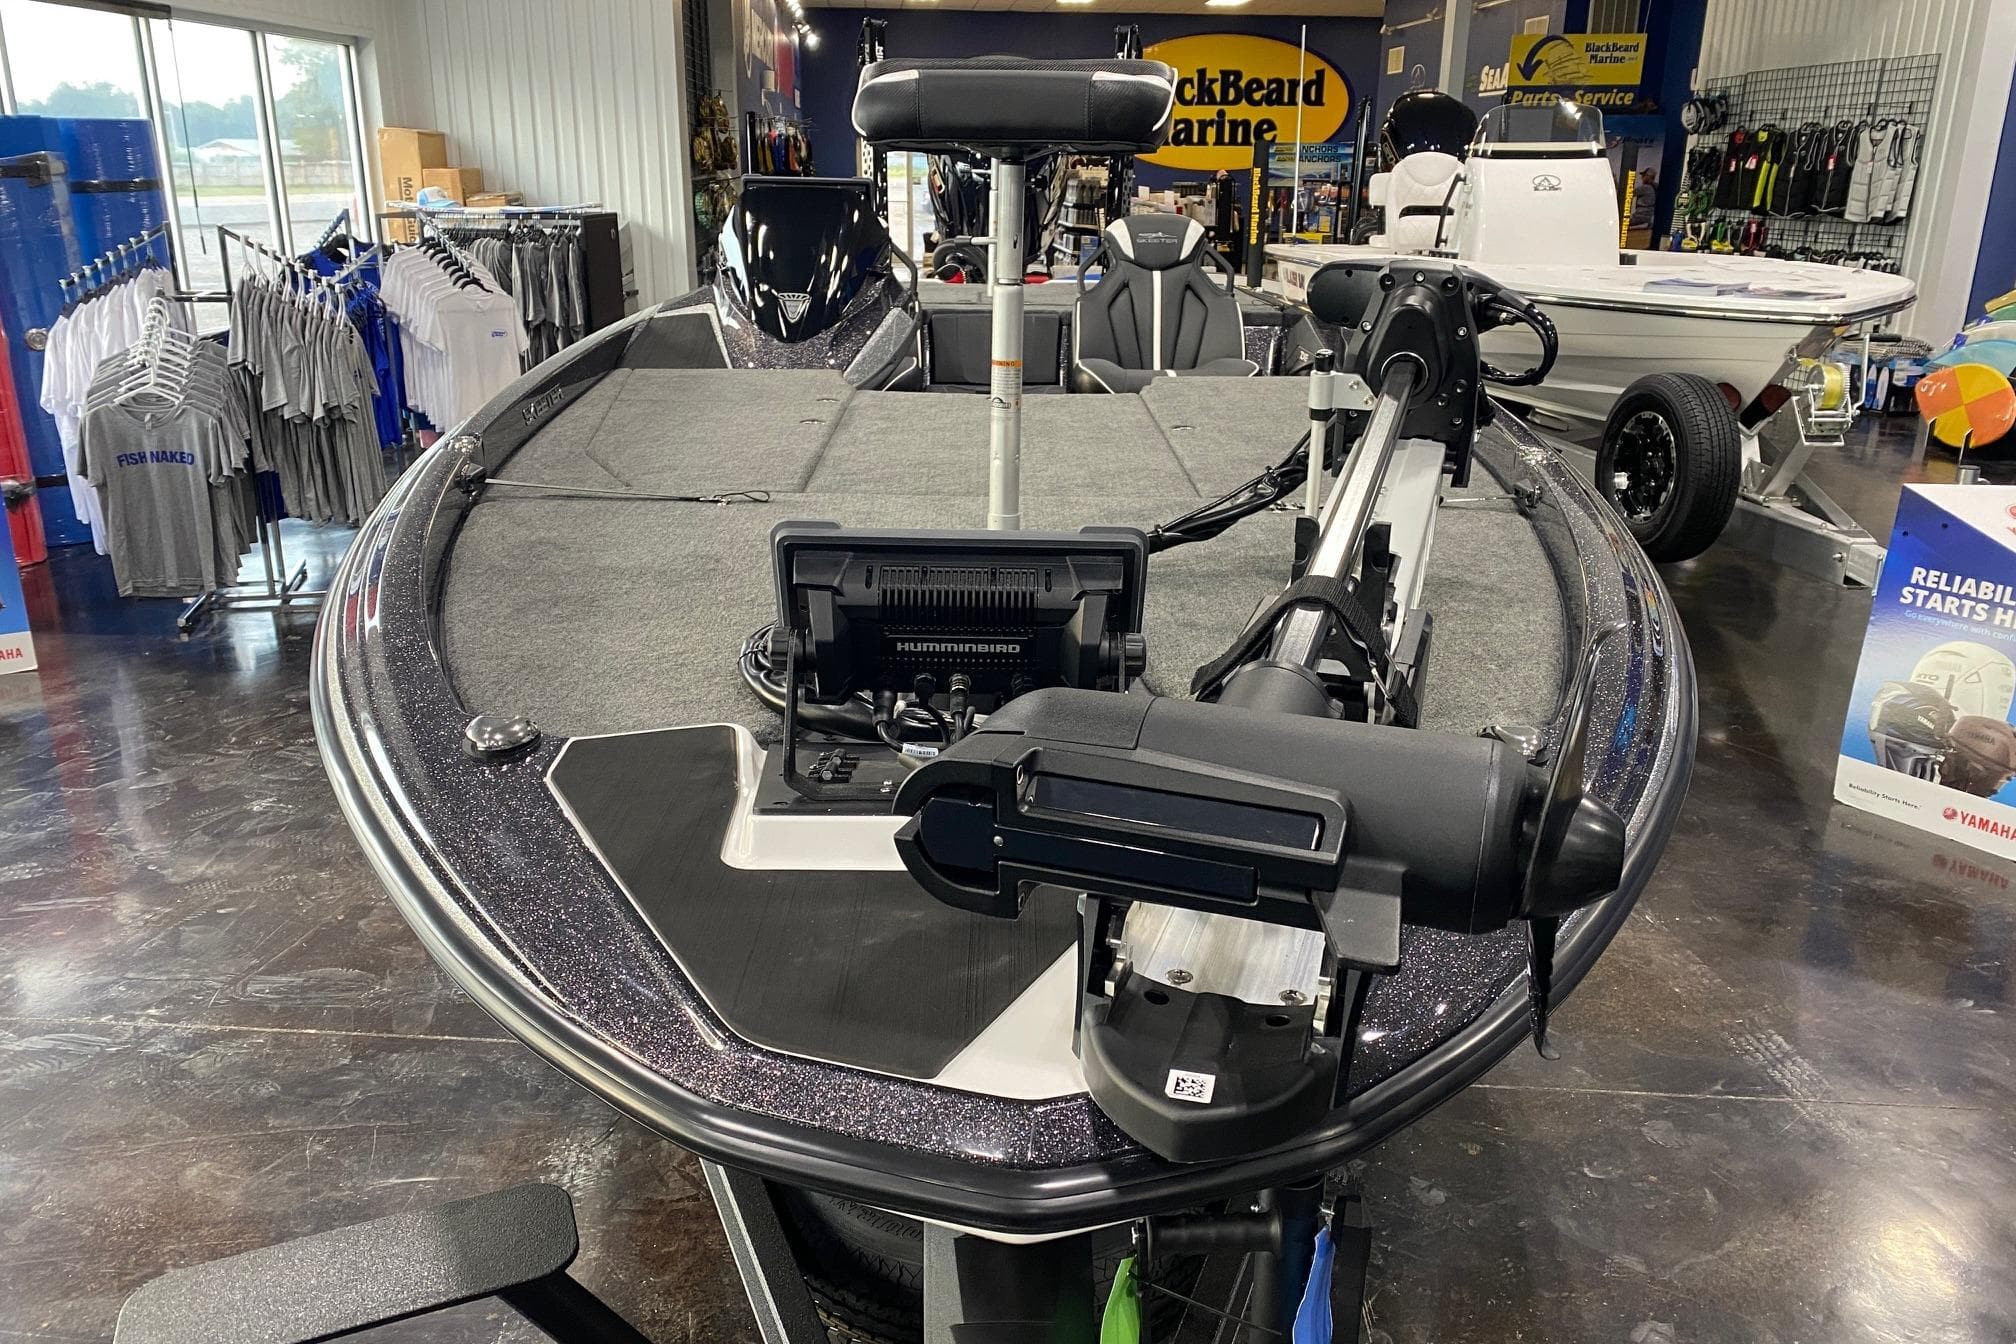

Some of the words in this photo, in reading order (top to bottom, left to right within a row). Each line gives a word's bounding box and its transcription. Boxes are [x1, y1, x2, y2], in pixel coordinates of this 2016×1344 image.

[1585, 42, 1640, 53] BlackBeard
[1589, 53, 1626, 64] Marine
[1174, 67, 1326, 107] ckBeard
[1511, 90, 1560, 107] Parts
[1575, 89, 1635, 105] Service
[1169, 108, 1278, 147] arine
[1302, 145, 1339, 153] NCHORS
[116, 451, 148, 468] FISH
[149, 450, 195, 466] NAKED
[1899, 586, 1990, 622] STARTS
[896, 642, 1020, 653] HUMMINBIRD
[1848, 783, 1881, 798] Reliability
[1882, 793, 1901, 804] Starts
